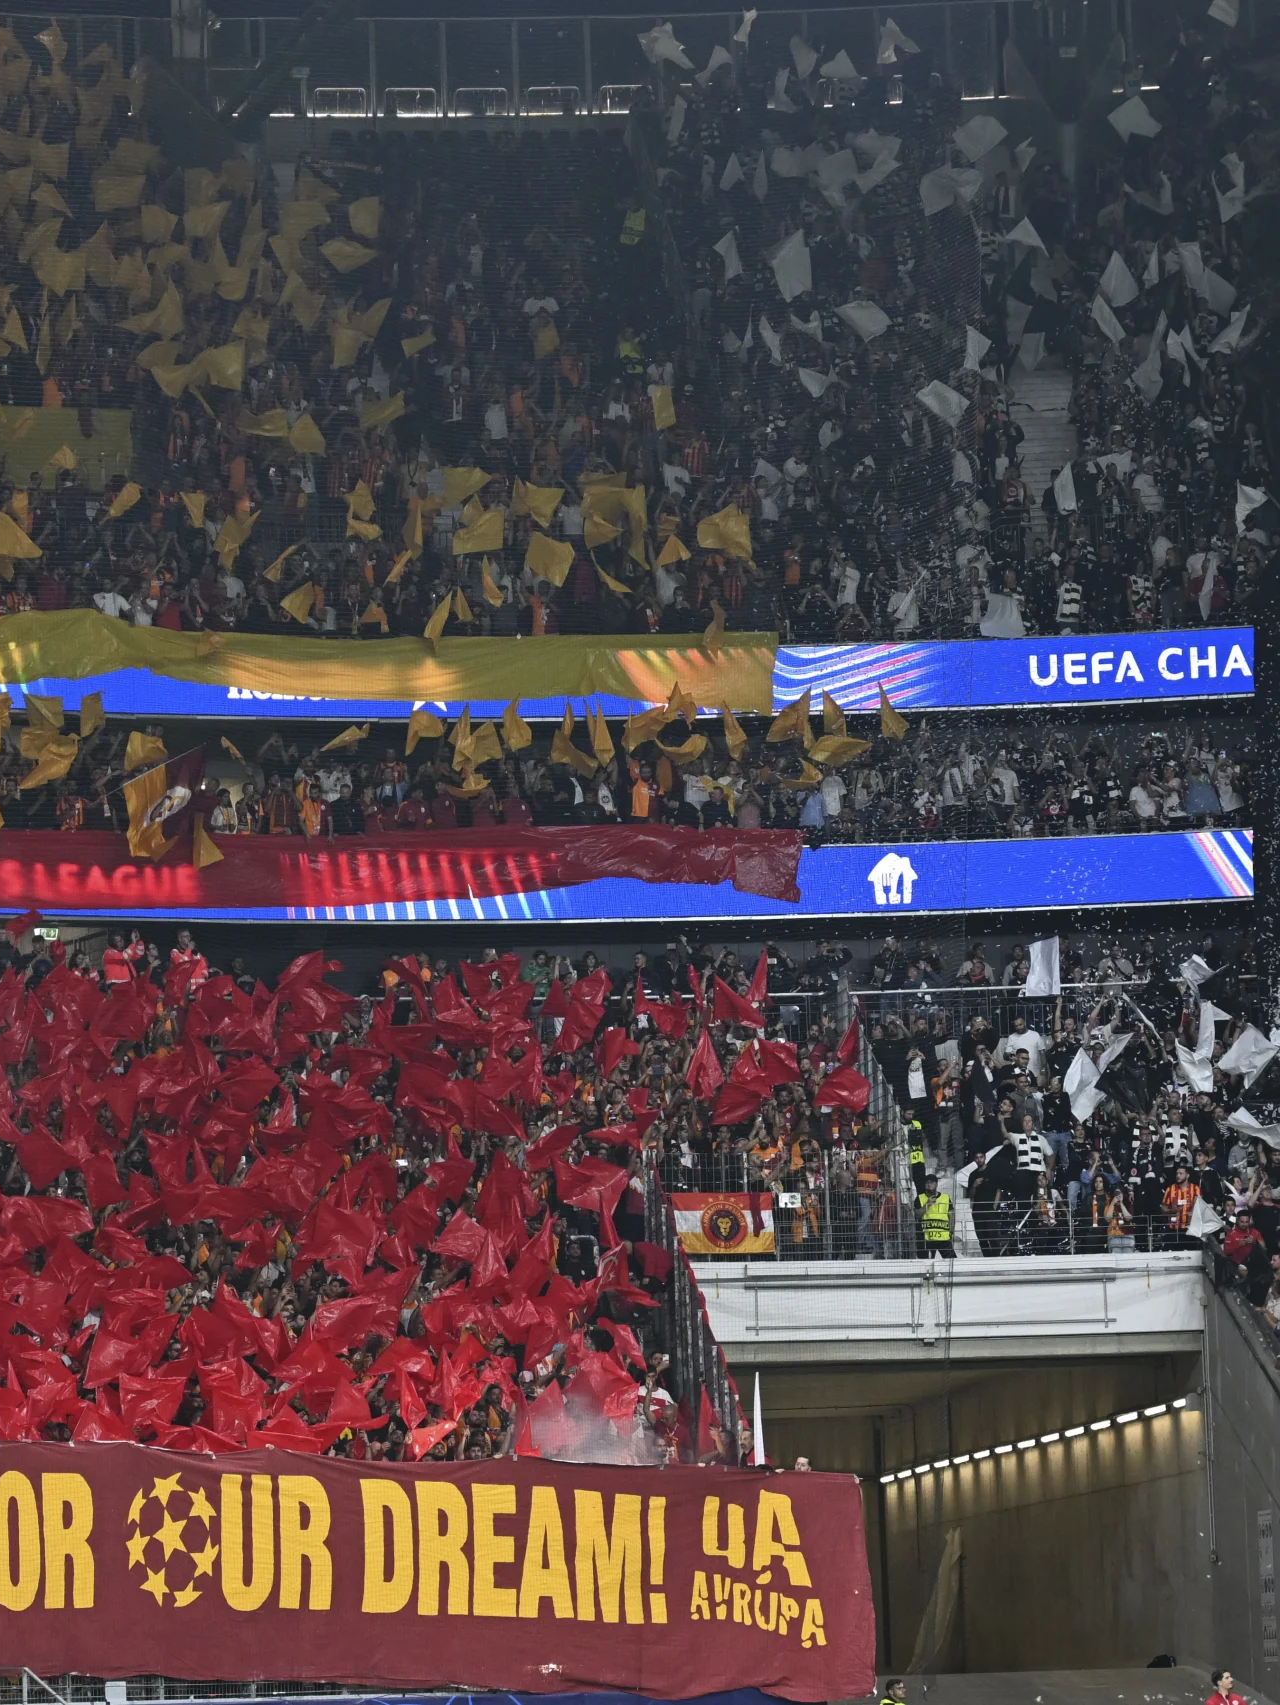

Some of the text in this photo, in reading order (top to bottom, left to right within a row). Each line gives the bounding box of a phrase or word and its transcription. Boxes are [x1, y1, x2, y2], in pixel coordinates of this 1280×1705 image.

[1029, 644, 1253, 687] UEFA CHA
[34, 861, 201, 904] LEAGUE
[360, 1478, 668, 1625] DREAM!
